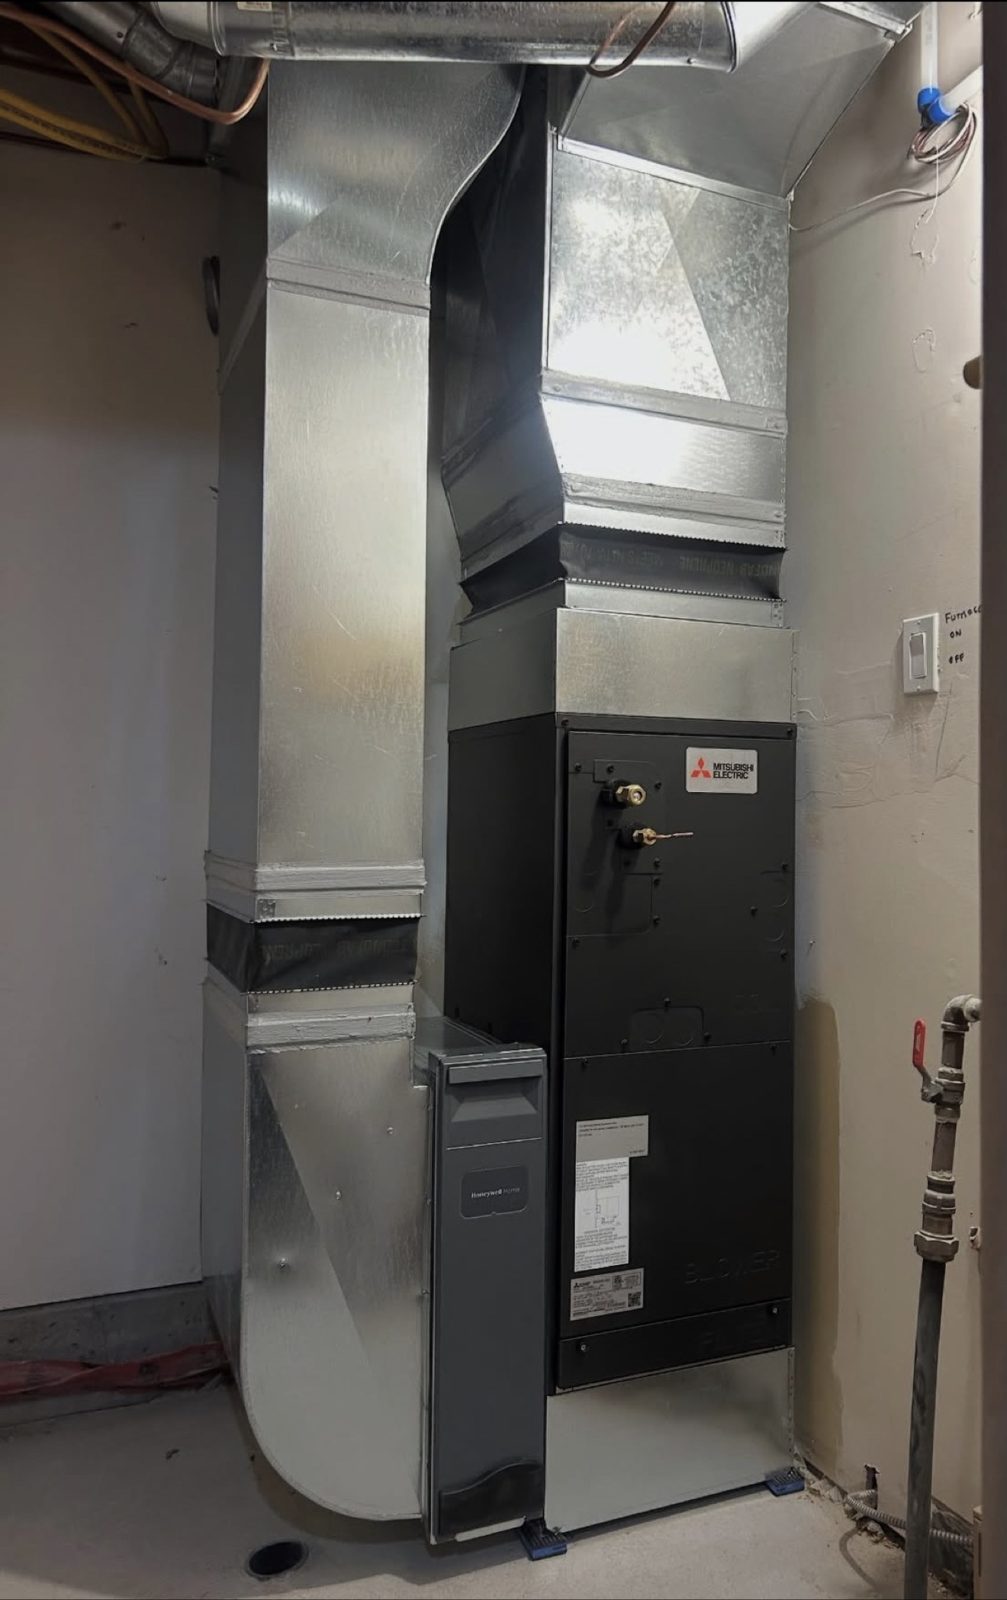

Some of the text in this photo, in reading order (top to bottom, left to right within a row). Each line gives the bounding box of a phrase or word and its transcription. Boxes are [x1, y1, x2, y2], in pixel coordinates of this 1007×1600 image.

[950, 629, 962, 639] ON
[949, 652, 965, 665] OFF
[713, 763, 755, 772] MITSUBISHI
[713, 771, 749, 779] ELECTRIC
[471, 1188, 502, 1198] Honeywell
[684, 1249, 780, 1285] BLOWER
